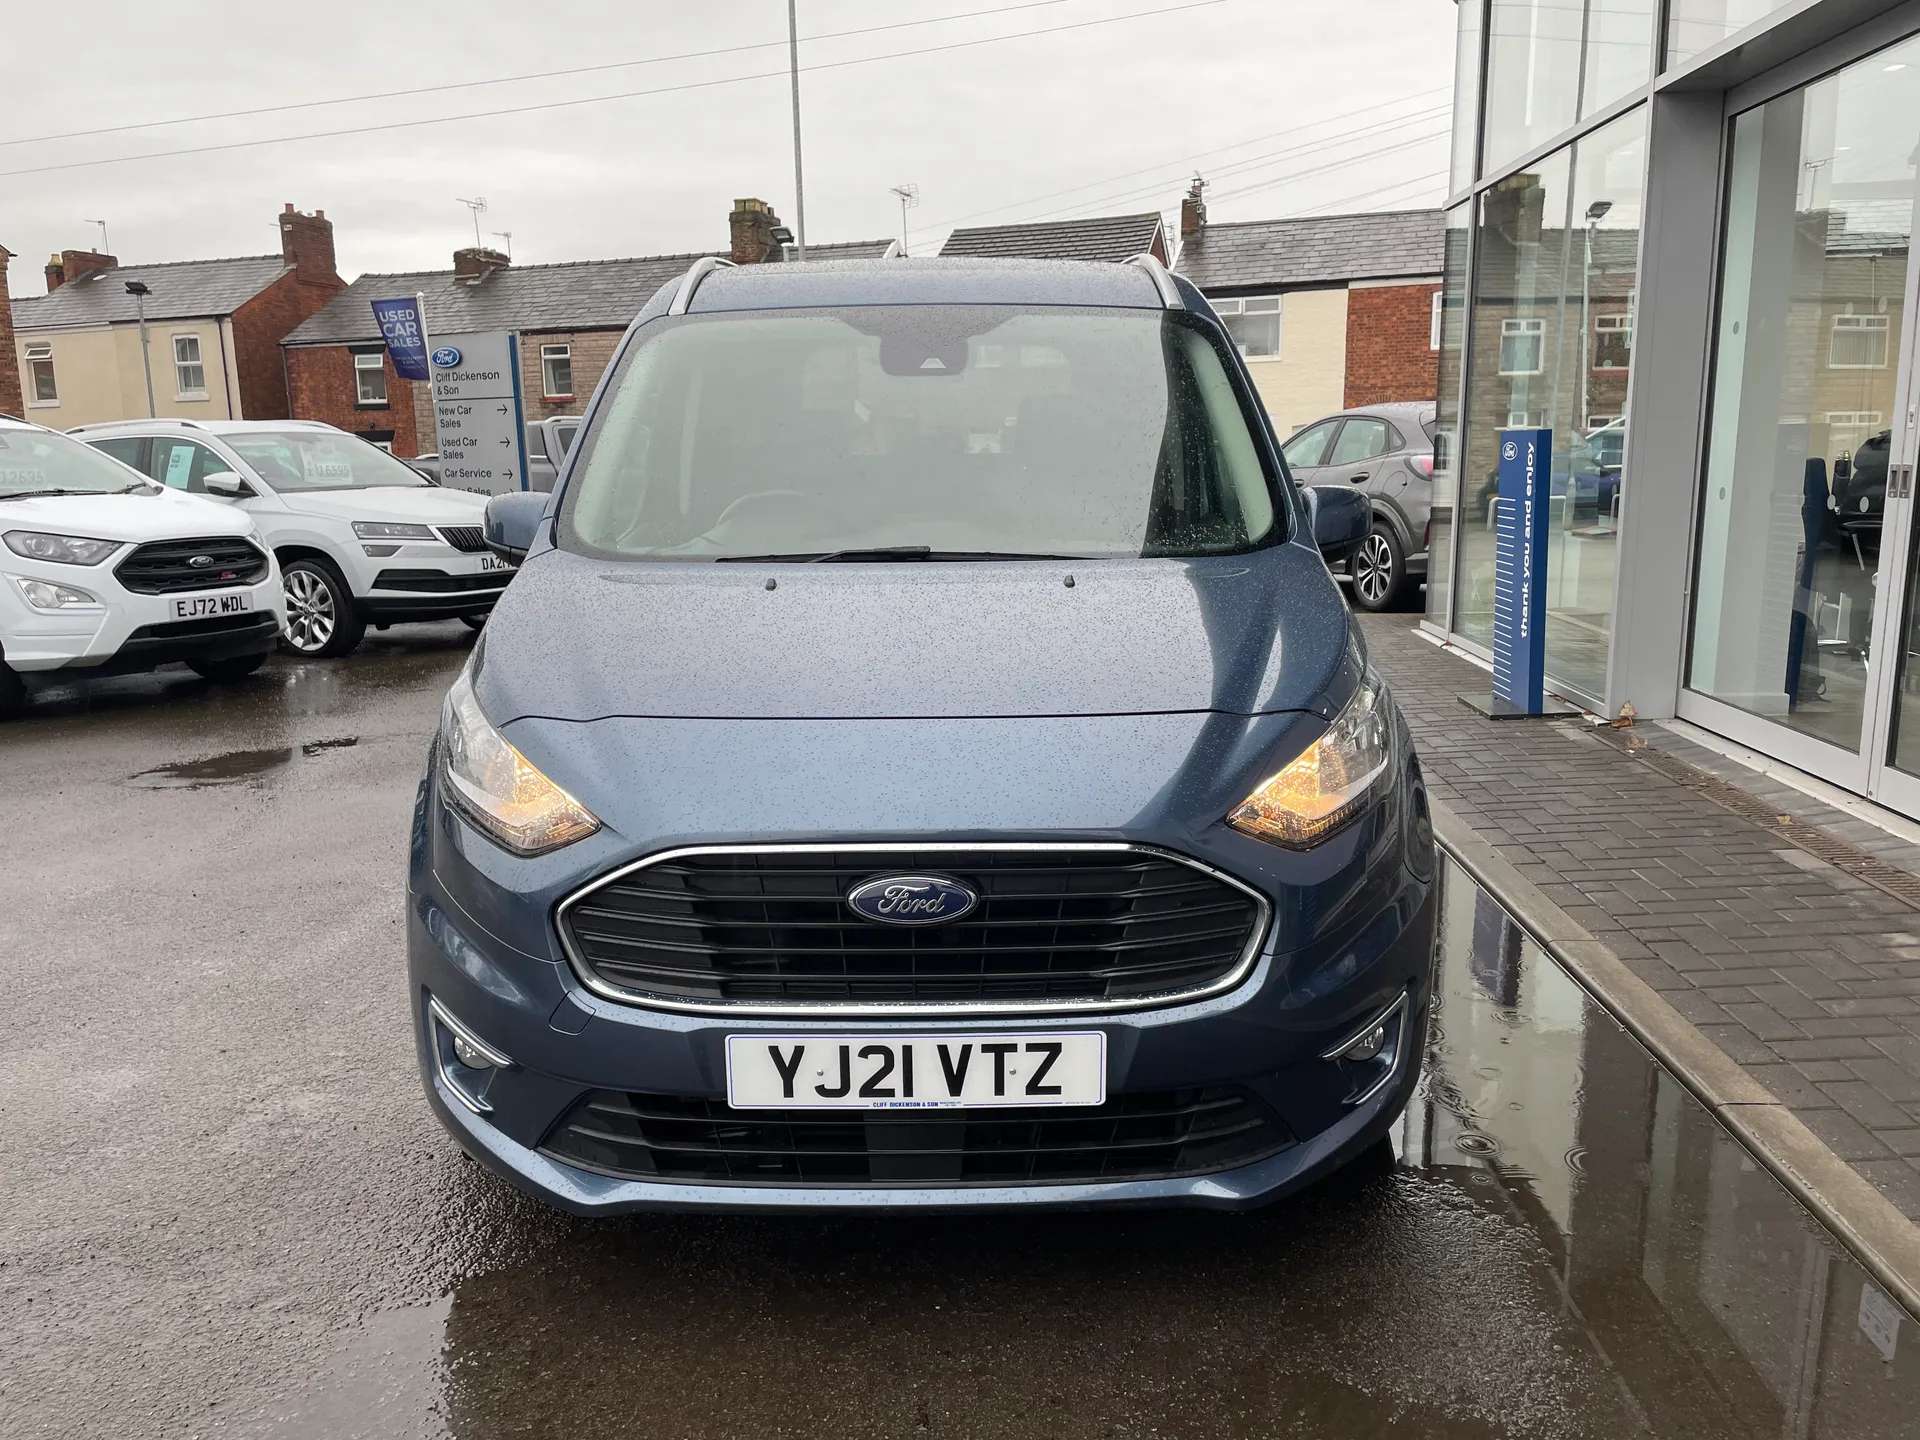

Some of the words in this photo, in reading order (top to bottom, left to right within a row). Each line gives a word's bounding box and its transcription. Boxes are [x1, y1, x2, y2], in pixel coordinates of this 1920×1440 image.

[379, 309, 415, 322] USED
[383, 321, 418, 337] CAR
[387, 336, 421, 348] SALES
[436, 350, 454, 364] Ford
[435, 371, 451, 383] Cliff
[452, 370, 500, 381] Dickenson
[437, 386, 442, 395] &
[443, 385, 460, 395] Son
[438, 406, 456, 416] New
[457, 405, 473, 415] Car
[440, 419, 461, 429] Sales
[441, 437, 461, 447] Used
[462, 437, 478, 447] Car
[443, 450, 464, 460] Sales
[444, 468, 458, 478] Car
[459, 468, 492, 478] Service
[1525, 442, 1535, 497] enjoy
[1524, 500, 1532, 539] and
[1523, 542, 1531, 578] you
[176, 598, 217, 617] EJ72
[220, 596, 248, 613] WDL
[1520, 581, 1529, 638] thank
[877, 885, 948, 914] Ford
[768, 1045, 914, 1099] YJ21
[937, 1042, 1062, 1097] VTZ
